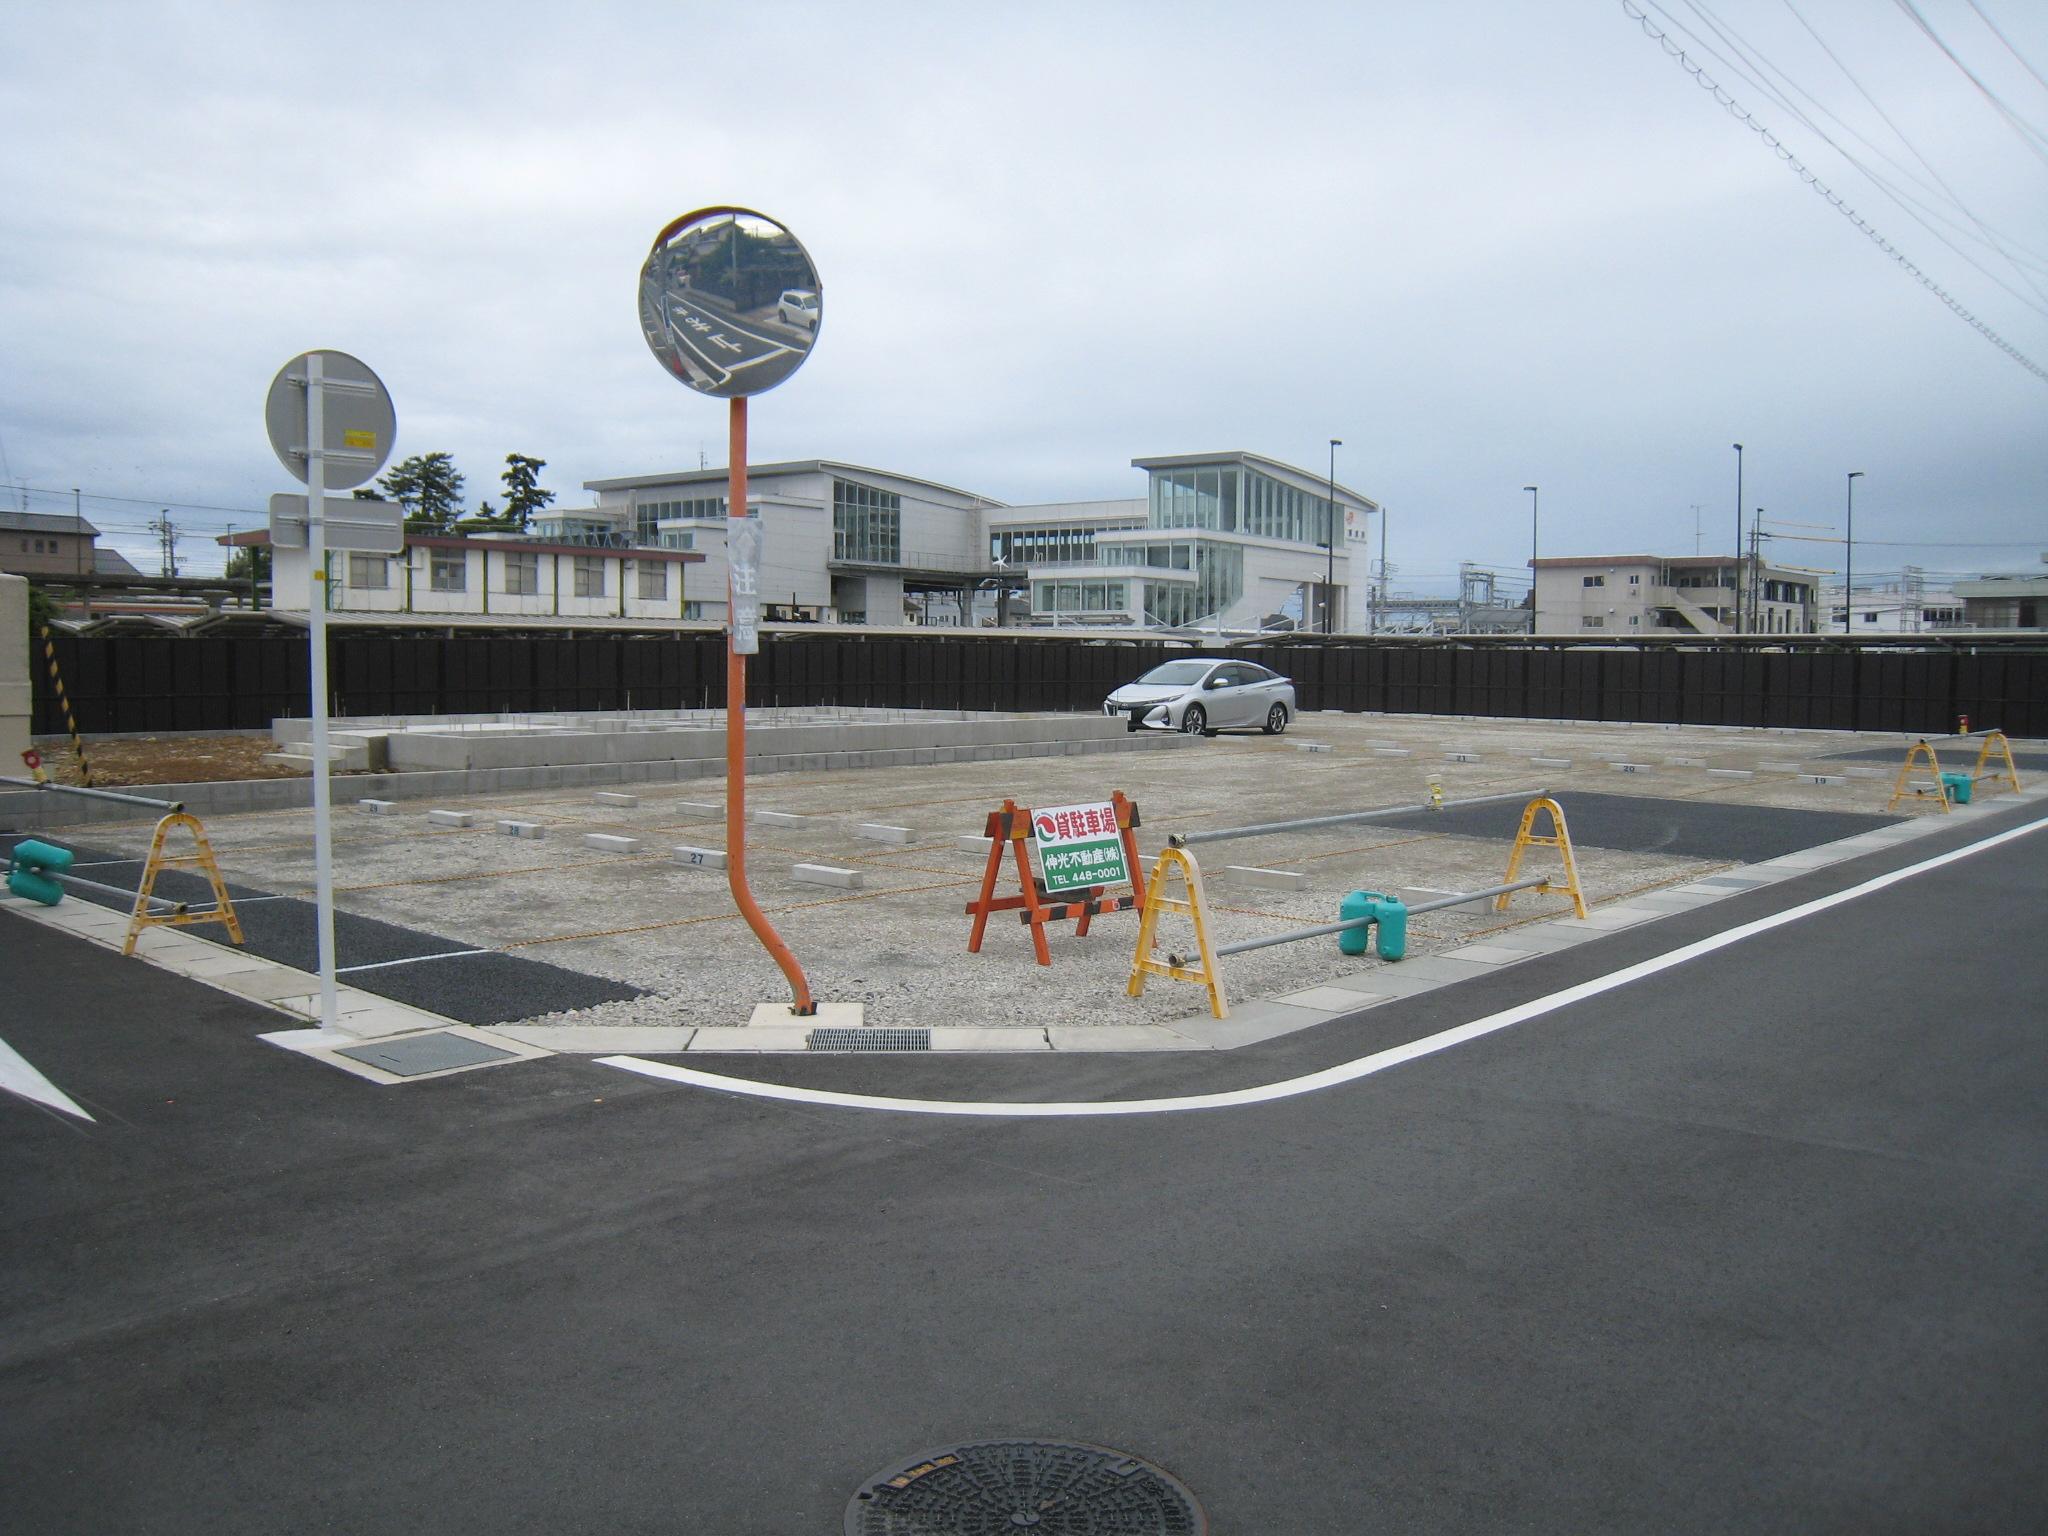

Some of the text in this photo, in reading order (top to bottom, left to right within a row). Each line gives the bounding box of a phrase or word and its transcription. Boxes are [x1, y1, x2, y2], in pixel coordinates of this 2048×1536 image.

[1623, 765, 1635, 773] 20
[1814, 777, 1827, 785] 19
[1055, 807, 1117, 840] 貸駐車場
[690, 852, 704, 865] 27
[1052, 867, 1121, 885] TEL 448-0001
